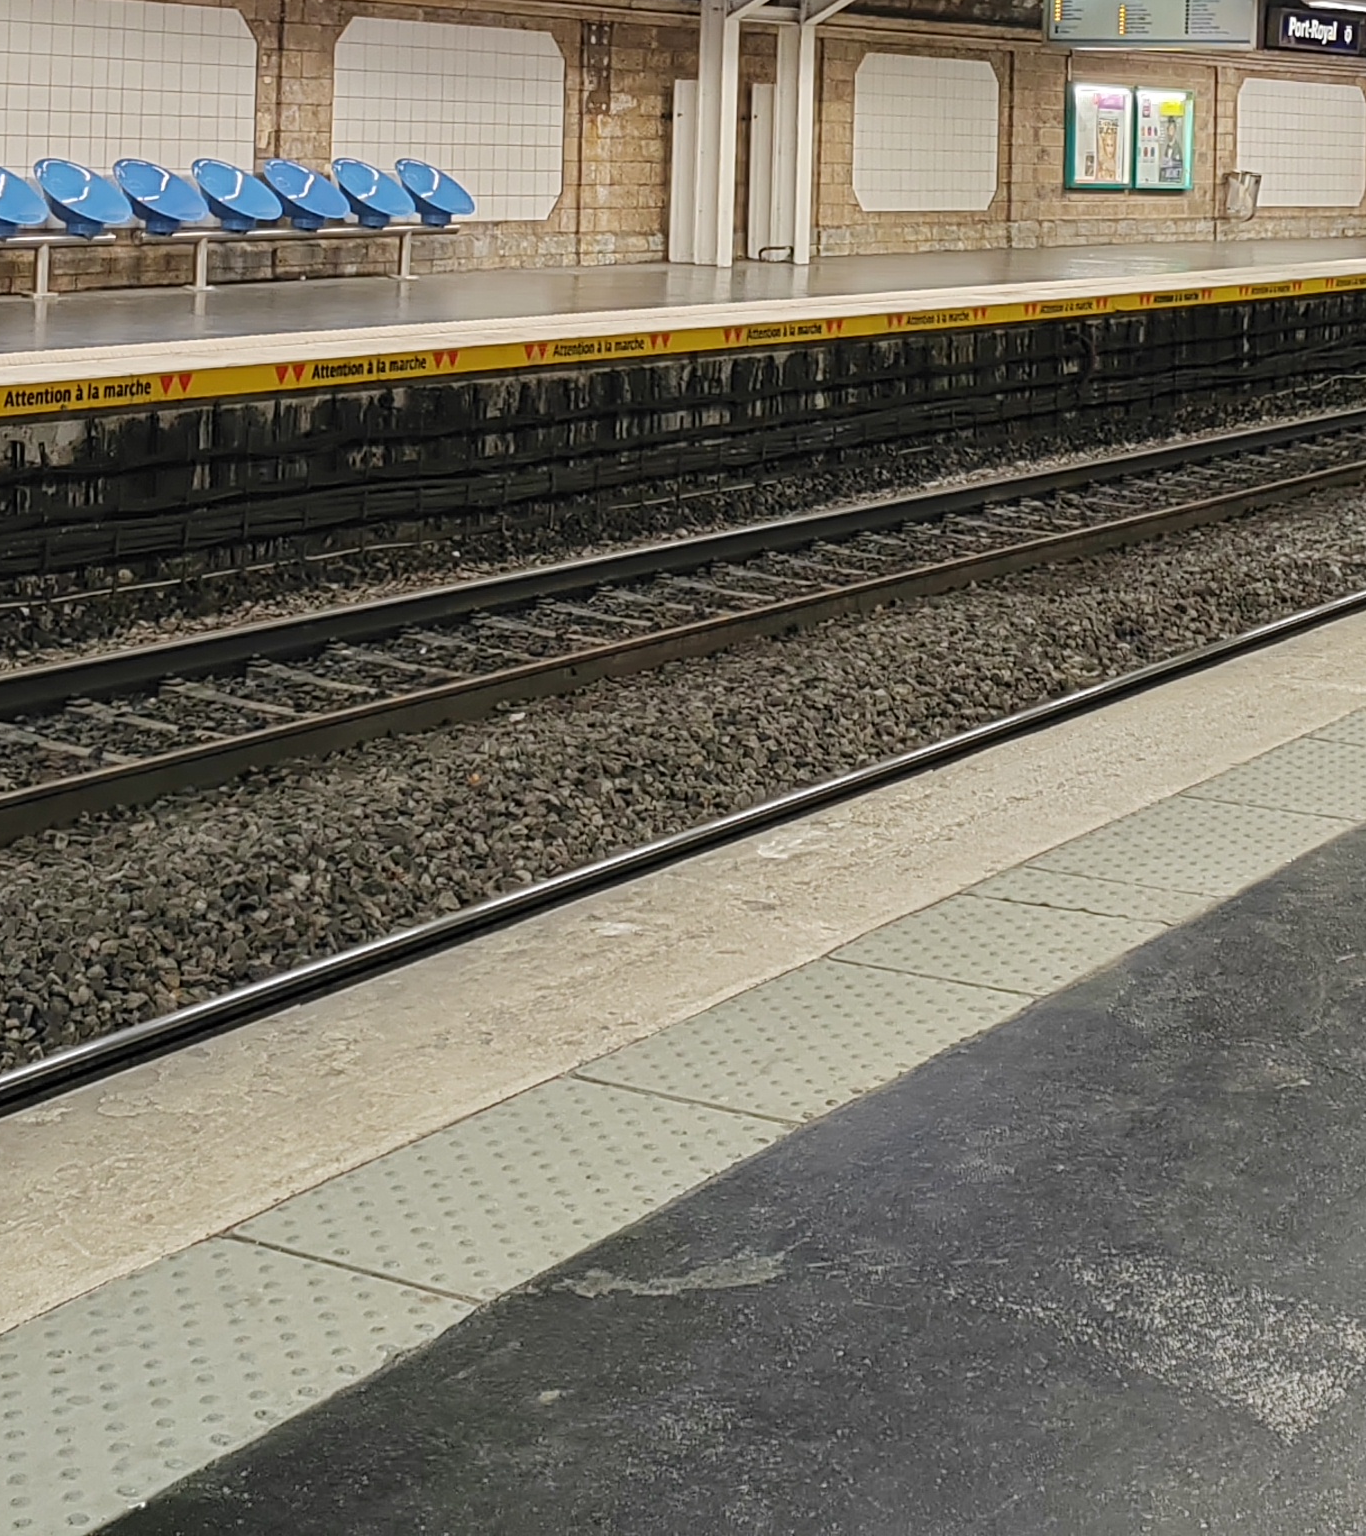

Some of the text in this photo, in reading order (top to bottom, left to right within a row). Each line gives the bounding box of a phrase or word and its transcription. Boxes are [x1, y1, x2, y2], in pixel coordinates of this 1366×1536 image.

[1288, 16, 1338, 45] Port-Royal
[311, 361, 364, 380] Attention
[376, 358, 386, 373] la
[389, 355, 427, 372] marche
[3, 379, 152, 408] Attention à la marche
